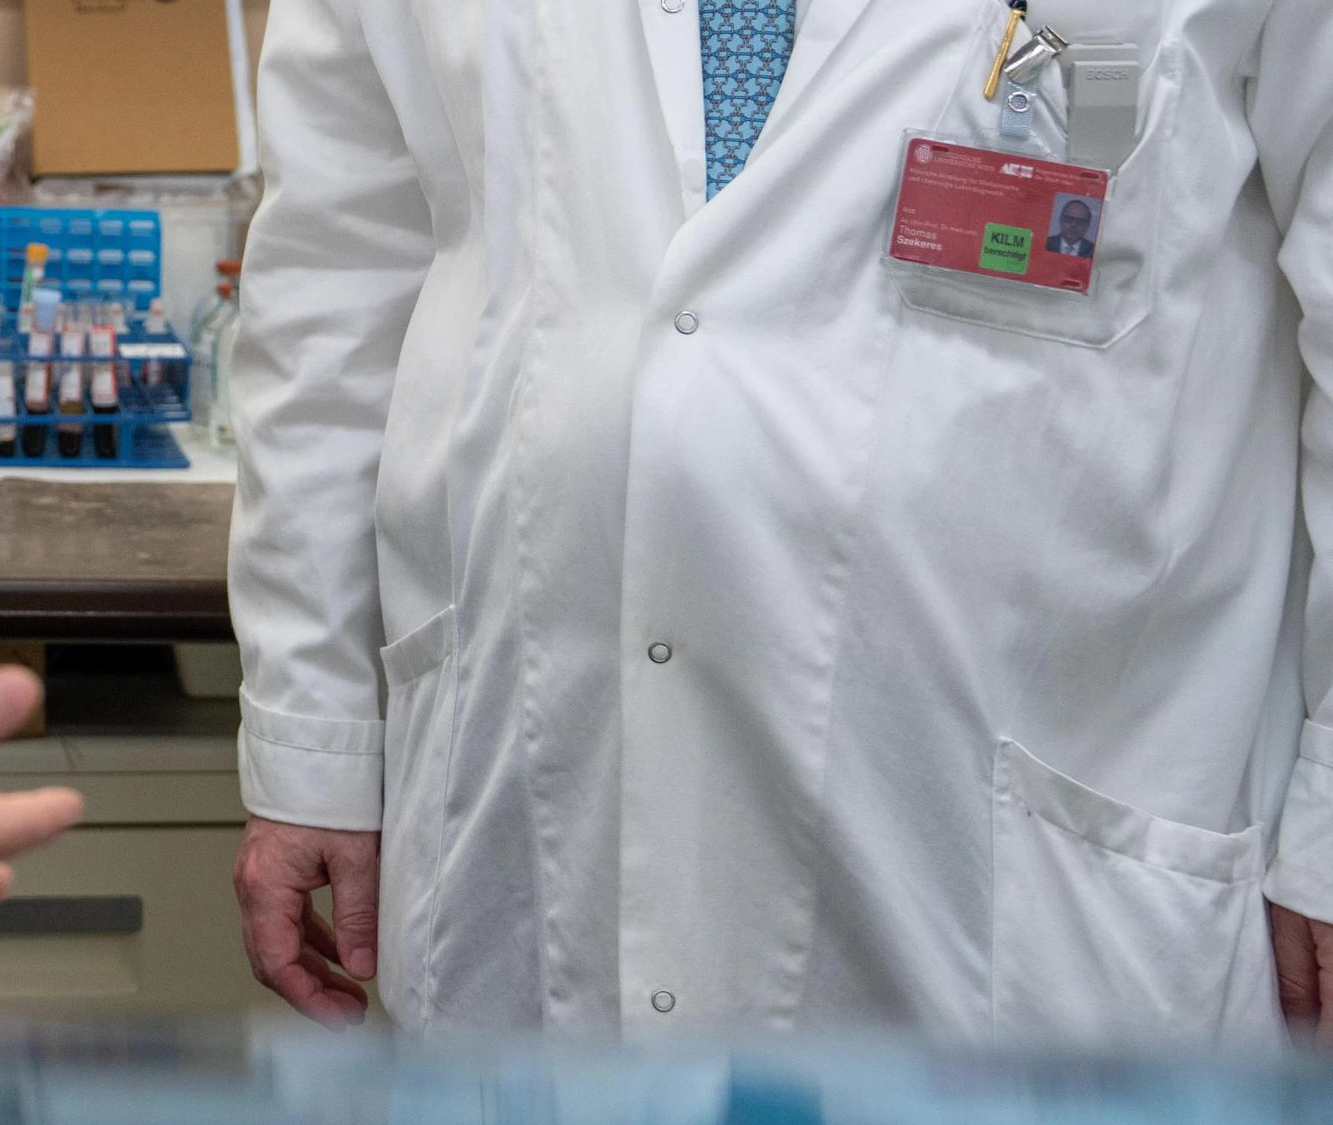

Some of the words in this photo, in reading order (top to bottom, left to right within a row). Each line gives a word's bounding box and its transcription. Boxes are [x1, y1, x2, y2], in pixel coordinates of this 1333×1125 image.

[1085, 68, 1129, 81] BOSCH
[899, 225, 937, 240] Thomas
[990, 231, 1025, 248] KILM
[896, 234, 942, 251] Szekeres
